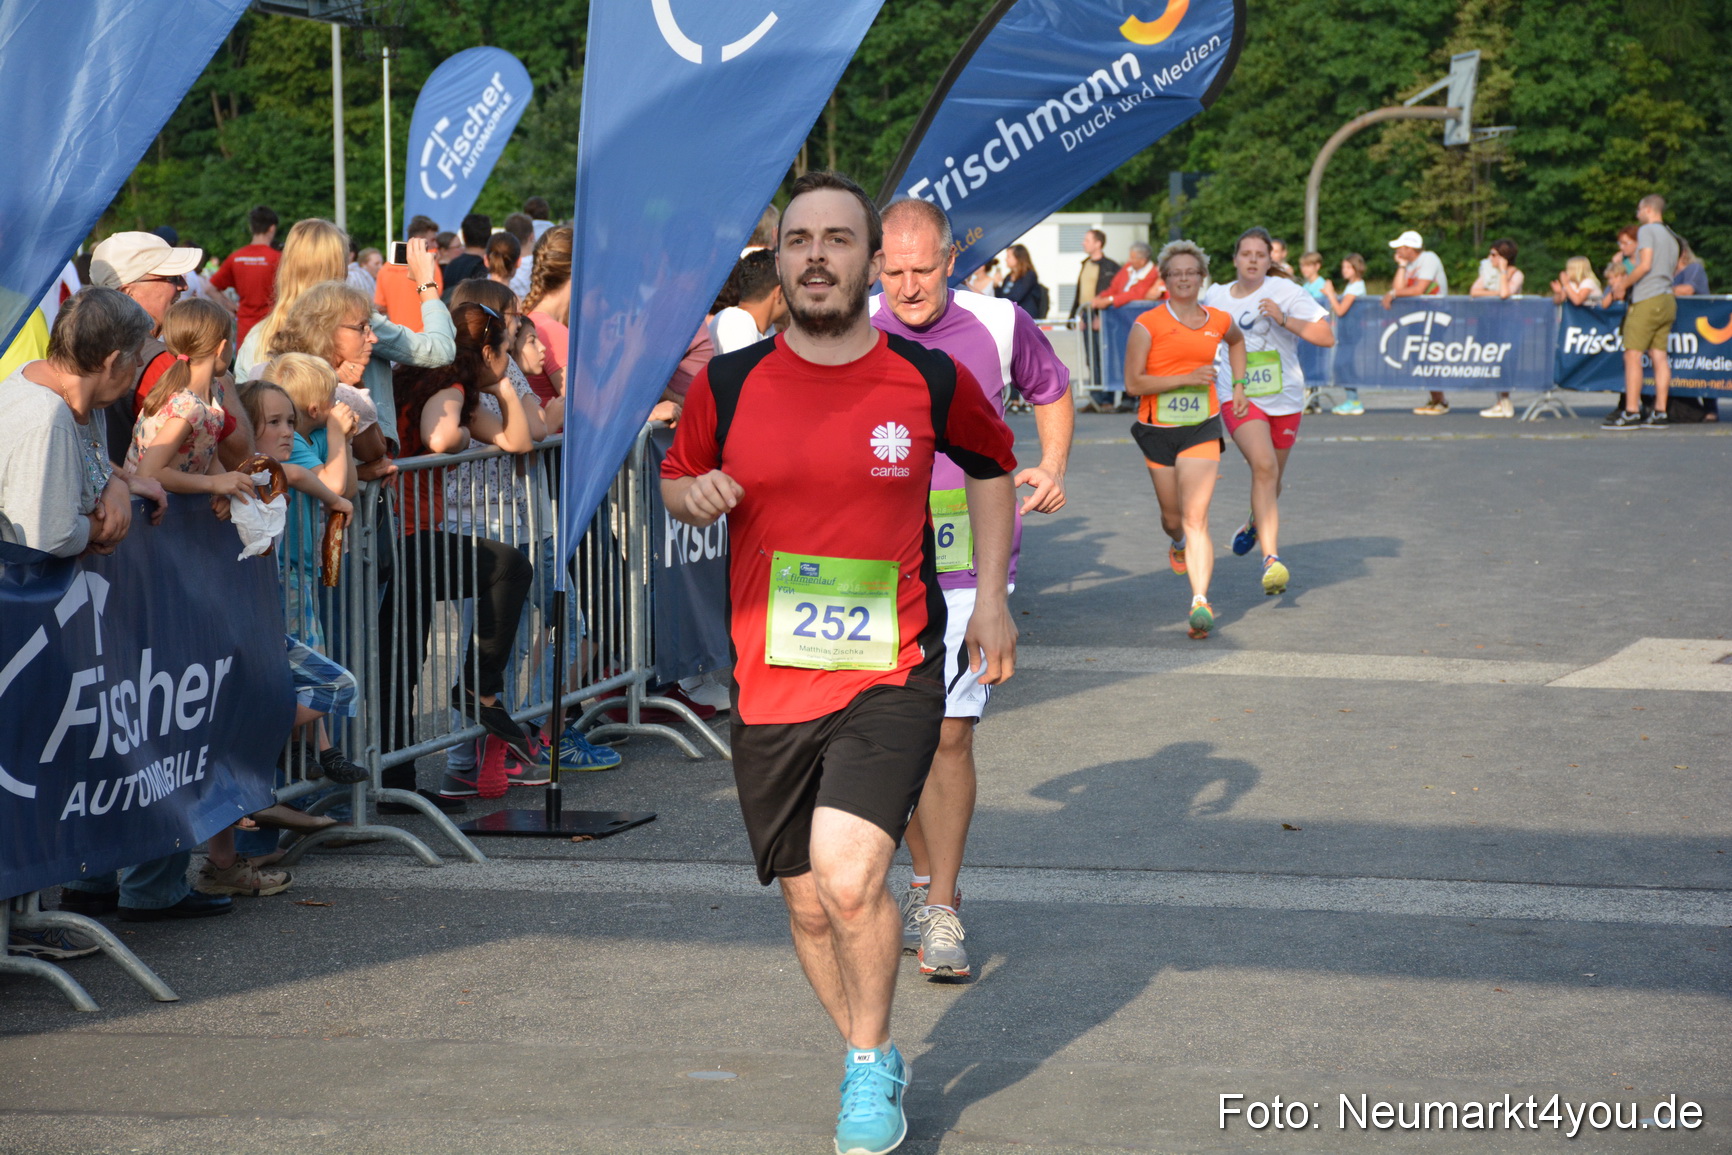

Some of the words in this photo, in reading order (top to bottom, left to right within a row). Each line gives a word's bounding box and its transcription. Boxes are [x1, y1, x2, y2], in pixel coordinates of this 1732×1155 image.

[1060, 103, 1116, 153] Druck
[1117, 81, 1155, 113] und
[1152, 34, 1222, 93] Medien
[437, 71, 505, 181] Fischer
[461, 92, 513, 179] AUTOMOBILE
[907, 52, 1141, 211] Frischmann
[1402, 335, 1512, 363] Fischer
[1674, 356, 1695, 369] und
[1696, 355, 1732, 371] Medie
[1412, 365, 1501, 378] AUTOMOBILE
[1168, 397, 1200, 412] 494
[870, 465, 910, 477] caritas
[793, 602, 871, 641] 252
[799, 645, 831, 655] Matthias
[833, 647, 864, 656] Zischka
[39, 648, 233, 764] Fischer
[59, 744, 209, 820] AUTOMOBILE
